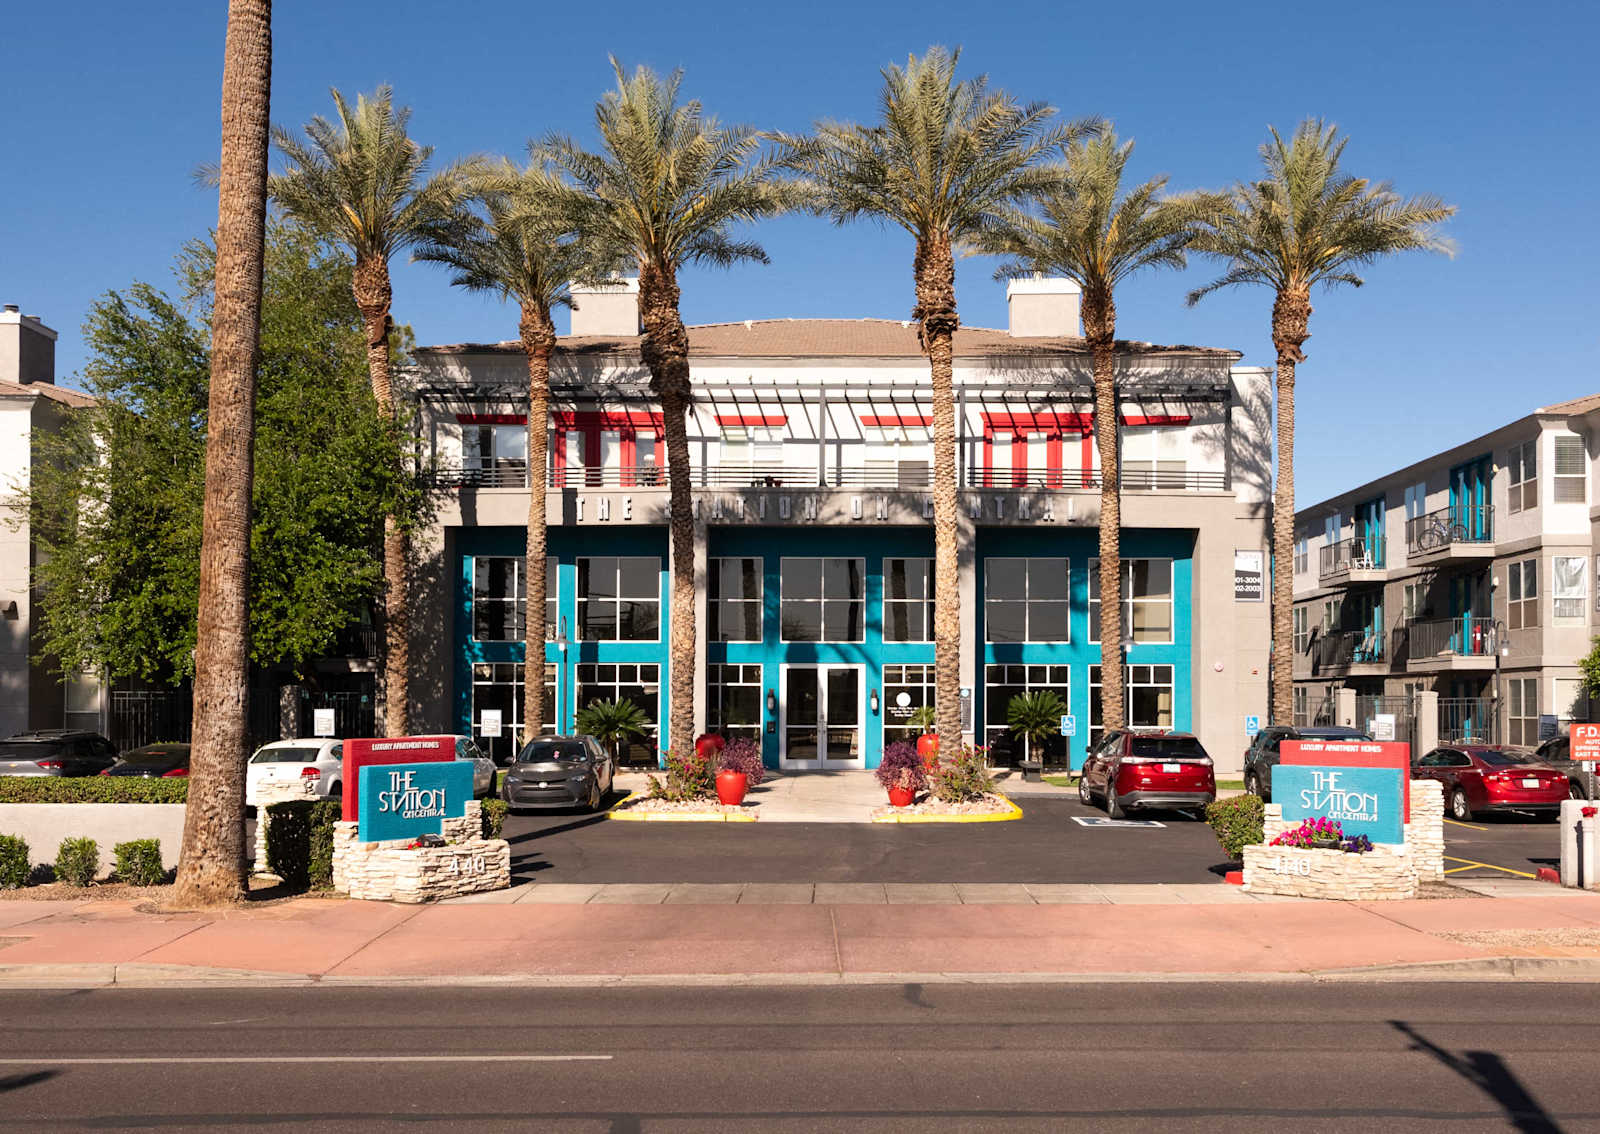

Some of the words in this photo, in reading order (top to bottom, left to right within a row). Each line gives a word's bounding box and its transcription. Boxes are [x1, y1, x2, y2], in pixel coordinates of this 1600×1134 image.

[575, 495, 632, 521] THE
[850, 495, 888, 521] ON
[922, 495, 1077, 522] CNTRAL
[1300, 743, 1324, 751] LUXURY
[1325, 744, 1359, 752] APARTMENT
[388, 771, 419, 792] THE
[1310, 771, 1346, 792] THE
[379, 788, 446, 813] STATION
[1300, 789, 1378, 813] STATION
[448, 855, 486, 876] 440
[1273, 856, 1312, 876] 440
